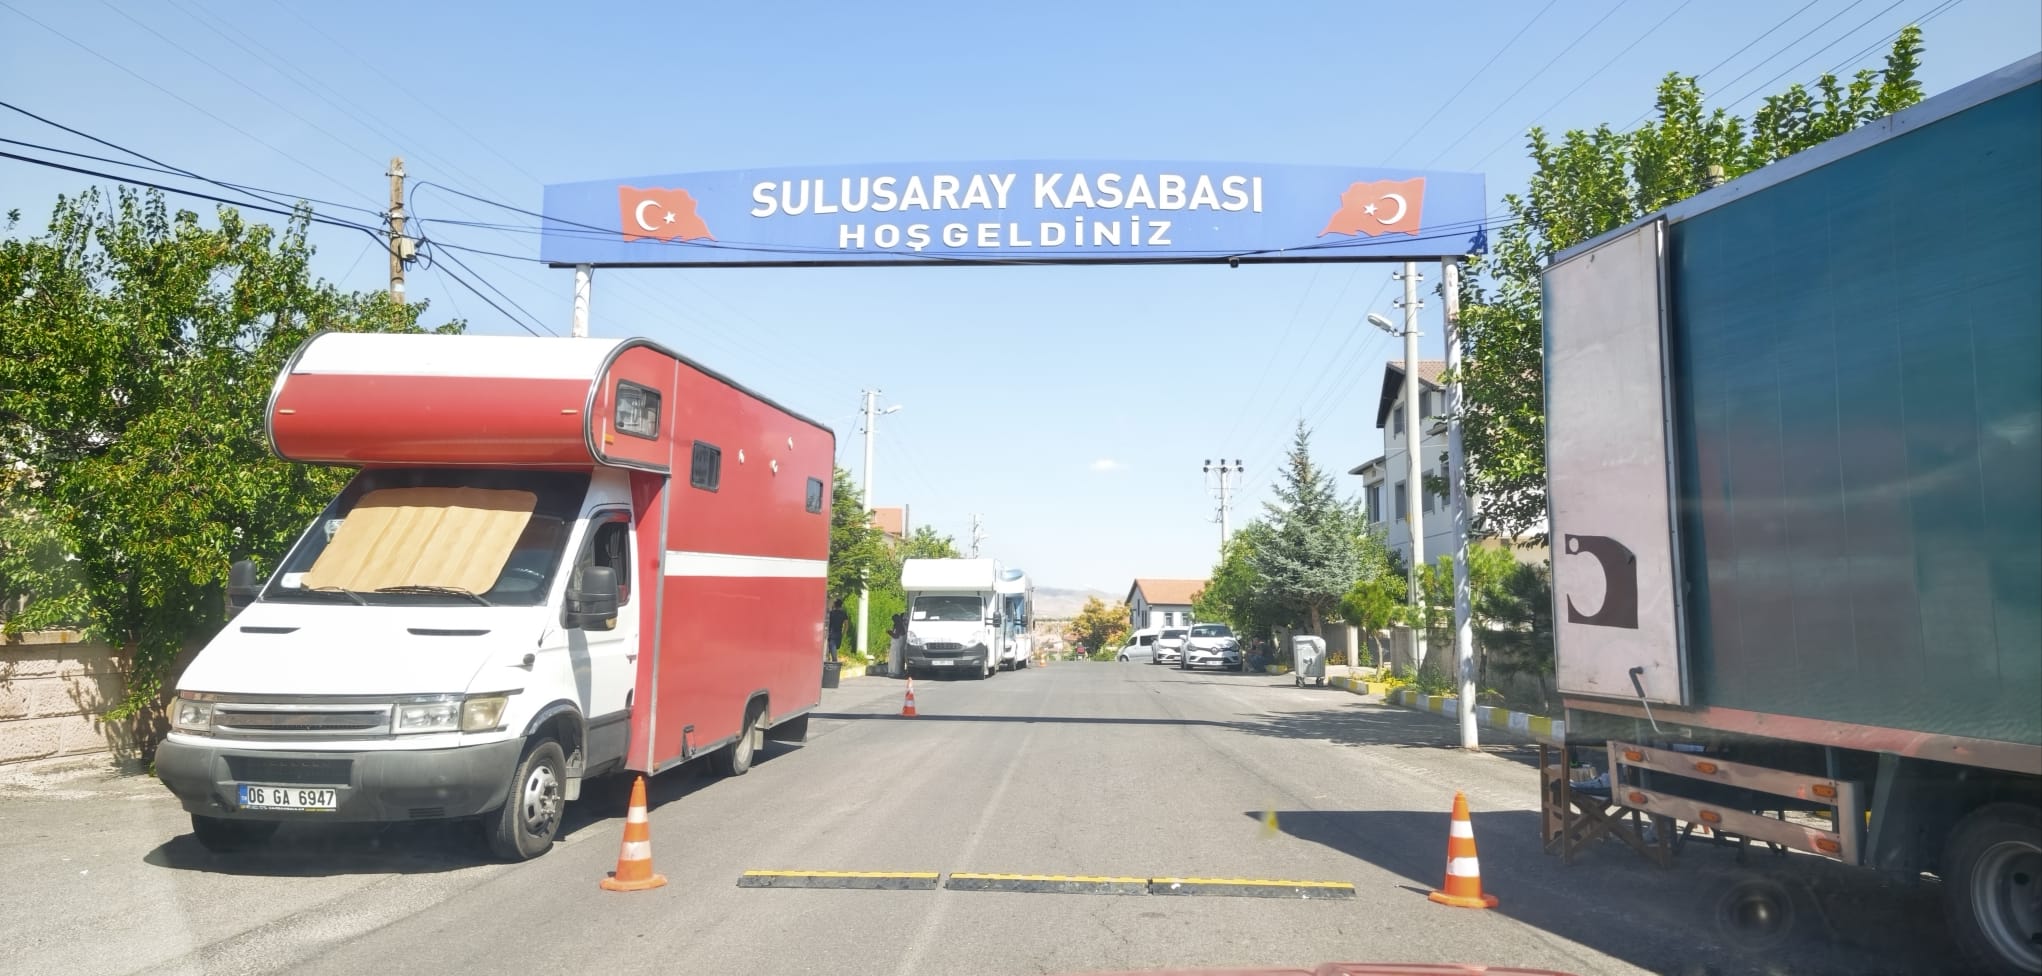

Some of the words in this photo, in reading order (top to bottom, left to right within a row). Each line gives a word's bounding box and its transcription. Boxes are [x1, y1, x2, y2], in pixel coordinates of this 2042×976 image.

[749, 172, 1017, 219] SULUSARAY
[1032, 170, 1265, 214] KASABASI
[248, 787, 265, 804] 06
[273, 789, 290, 805] GA
[299, 790, 334, 806] 6947
